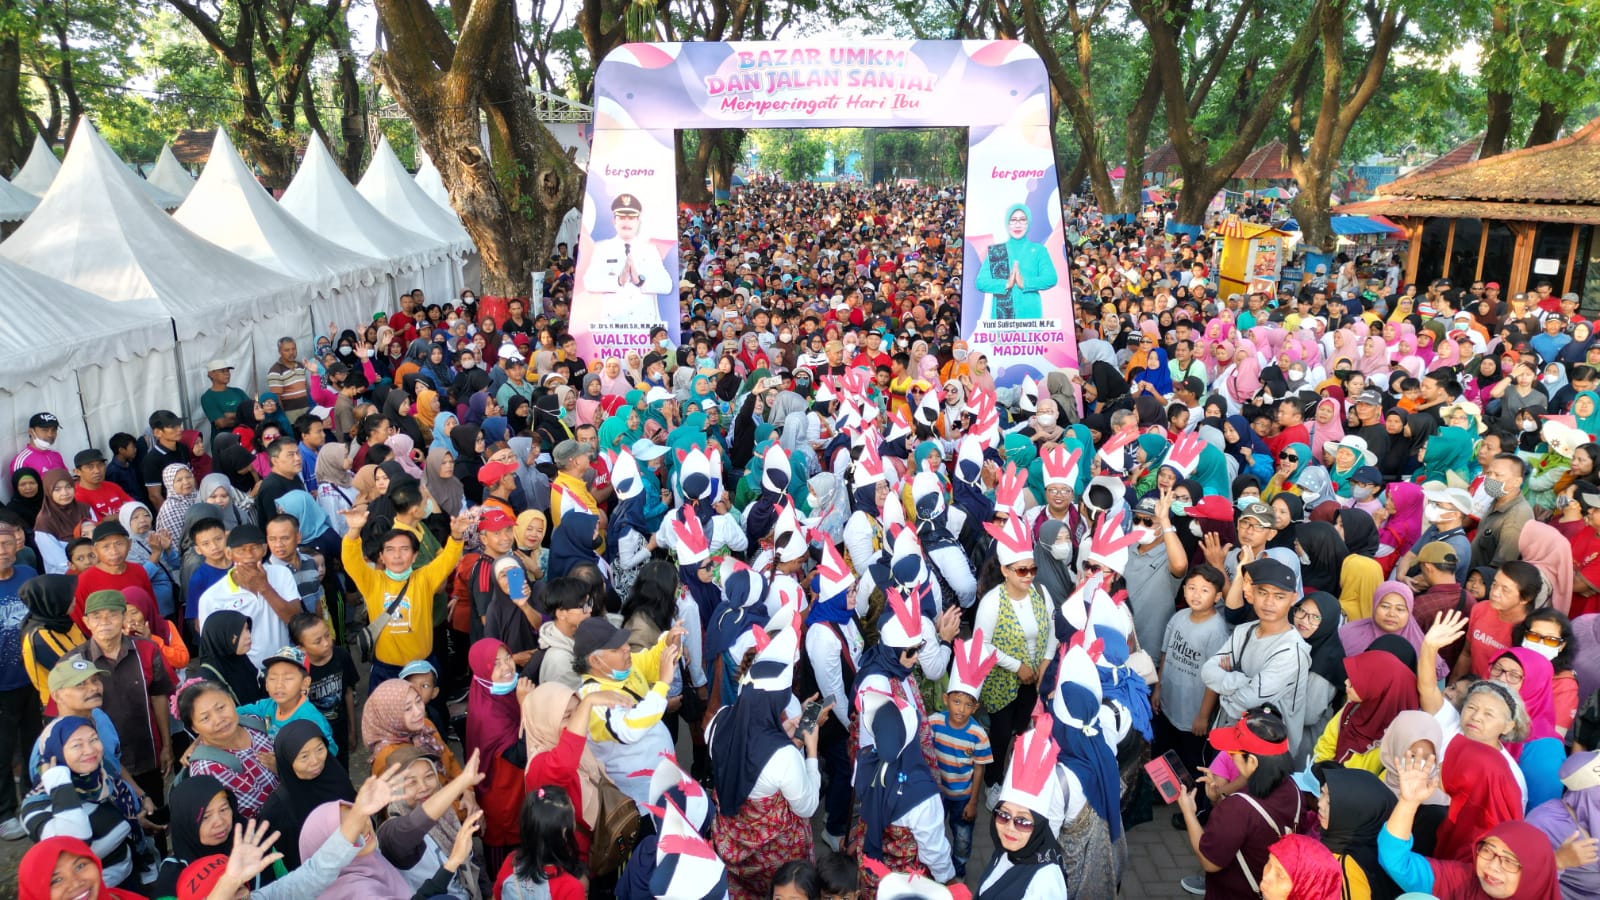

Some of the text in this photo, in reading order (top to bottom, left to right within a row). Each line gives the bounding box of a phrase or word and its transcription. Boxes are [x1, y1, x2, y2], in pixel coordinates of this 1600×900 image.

[737, 47, 905, 69] BAZAR UMKM
[707, 69, 934, 95] DAN JALAN SANTAI
[720, 93, 920, 115] Memperingati Hari Ibu
[605, 163, 655, 179] bersama
[991, 165, 1045, 181] bersama
[973, 331, 1065, 344] IBU WALIKOTA
